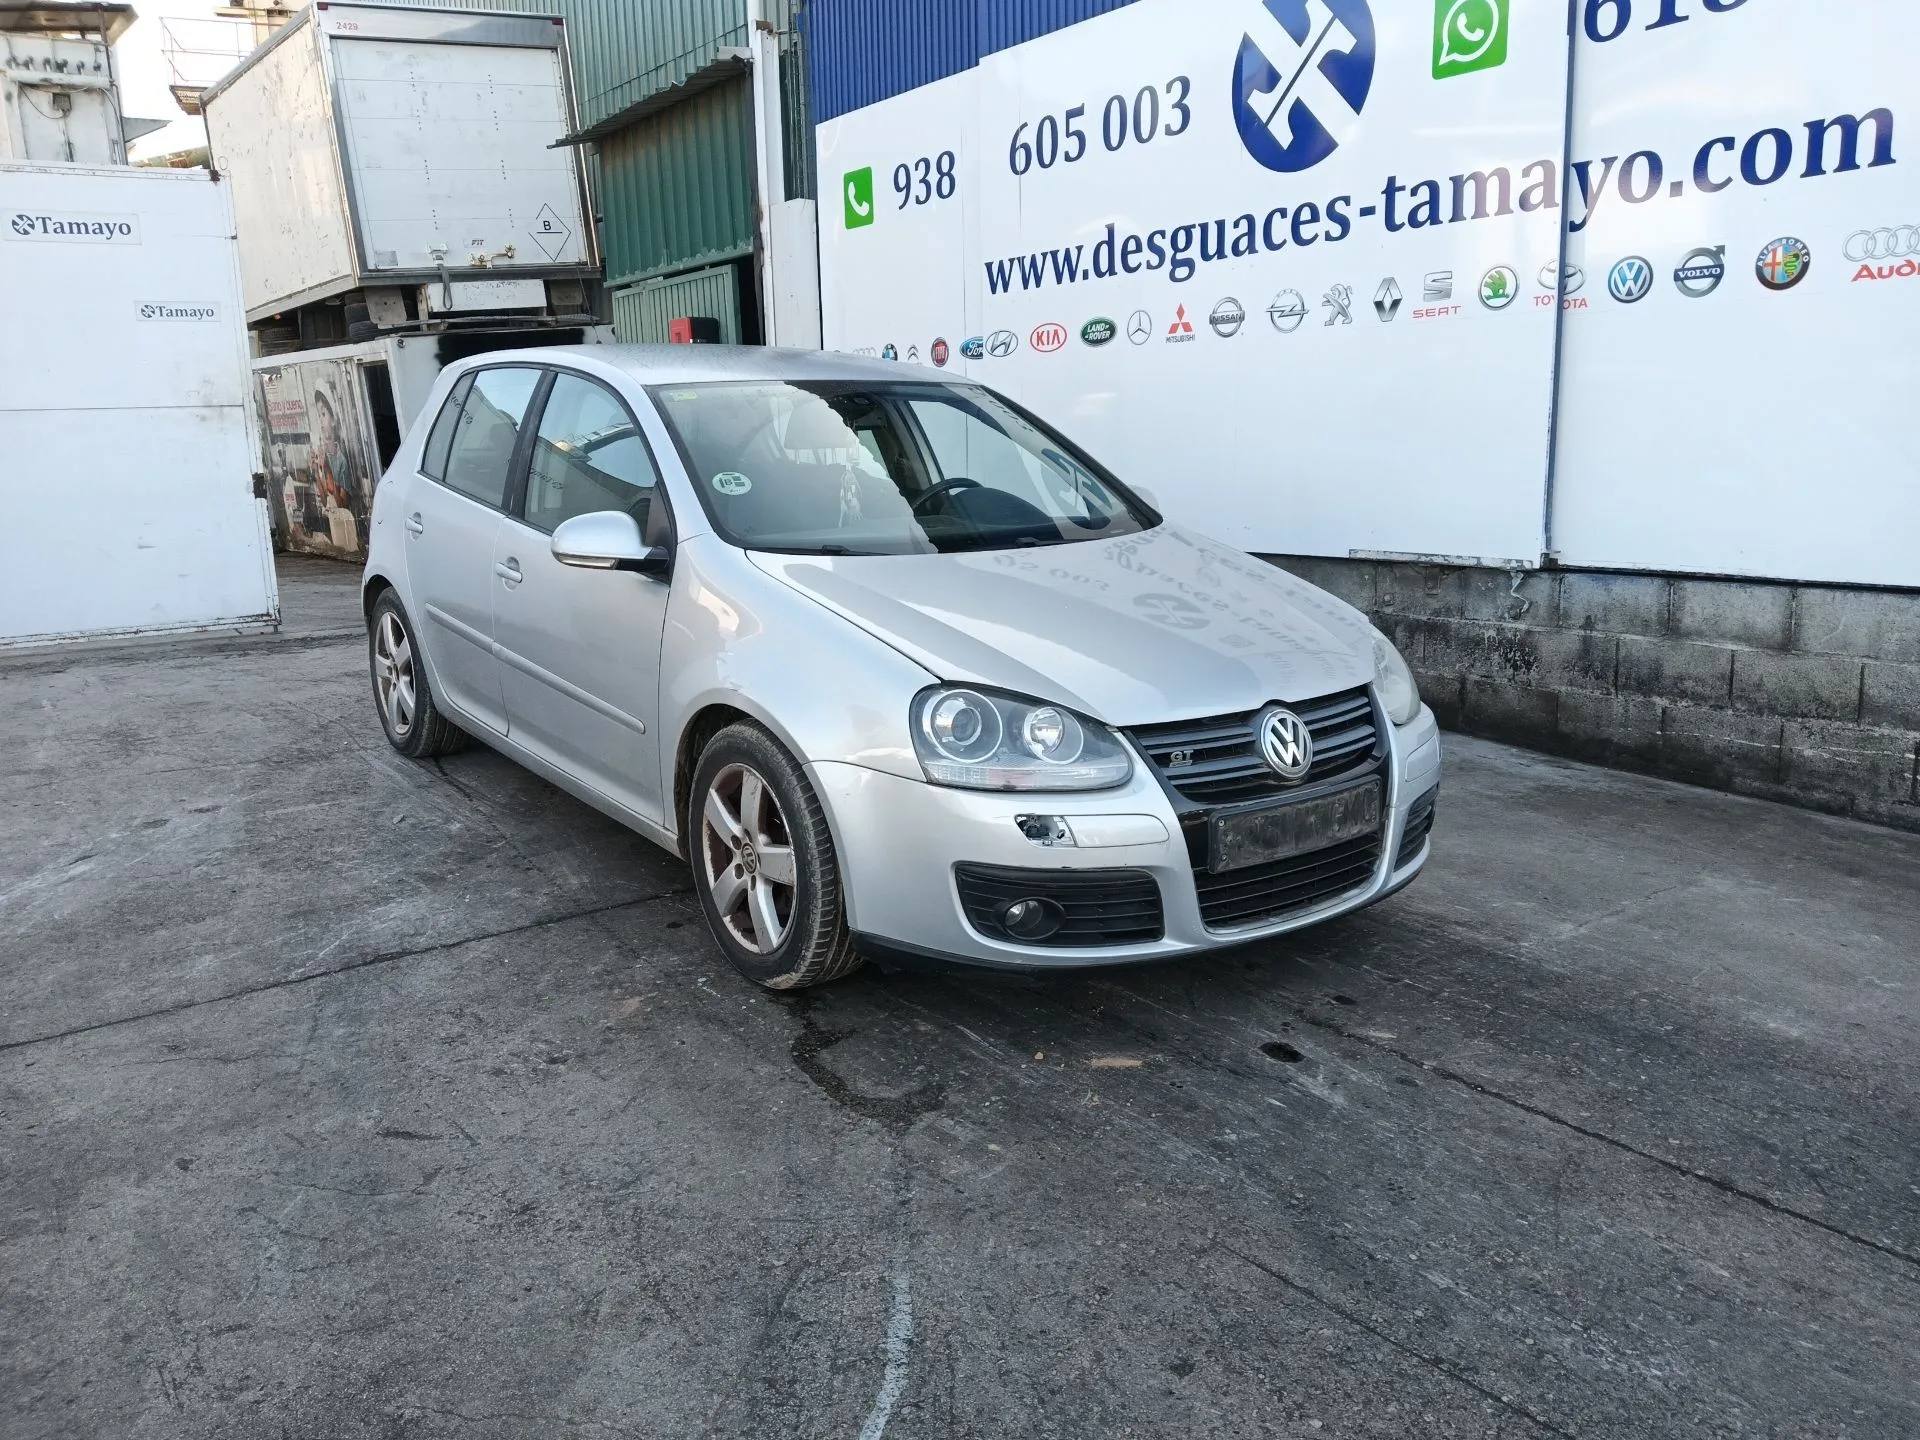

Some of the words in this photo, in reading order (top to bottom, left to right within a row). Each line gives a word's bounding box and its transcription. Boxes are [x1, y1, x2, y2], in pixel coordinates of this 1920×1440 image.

[336, 21, 359, 31] 2429
[892, 149, 957, 211] 938
[1008, 102, 1087, 178] 605
[1101, 74, 1192, 155] 003
[984, 106, 1897, 296] www.desguaces-tamayo.com
[35, 216, 132, 240] Tamayo
[543, 220, 552, 231] B
[1756, 244, 1774, 267] ALFA
[1782, 238, 1810, 263] ROMEO
[1676, 266, 1721, 280] VOLVO
[1533, 293, 1588, 310] TOOTA
[155, 305, 215, 321] Tamayo
[1212, 312, 1243, 323] NISSAN
[1412, 305, 1462, 319] SEAT
[1086, 322, 1105, 333] LAND
[1036, 329, 1061, 347] KIA
[1087, 330, 1111, 341] ROVER
[1165, 333, 1196, 345] MITSUBISHI
